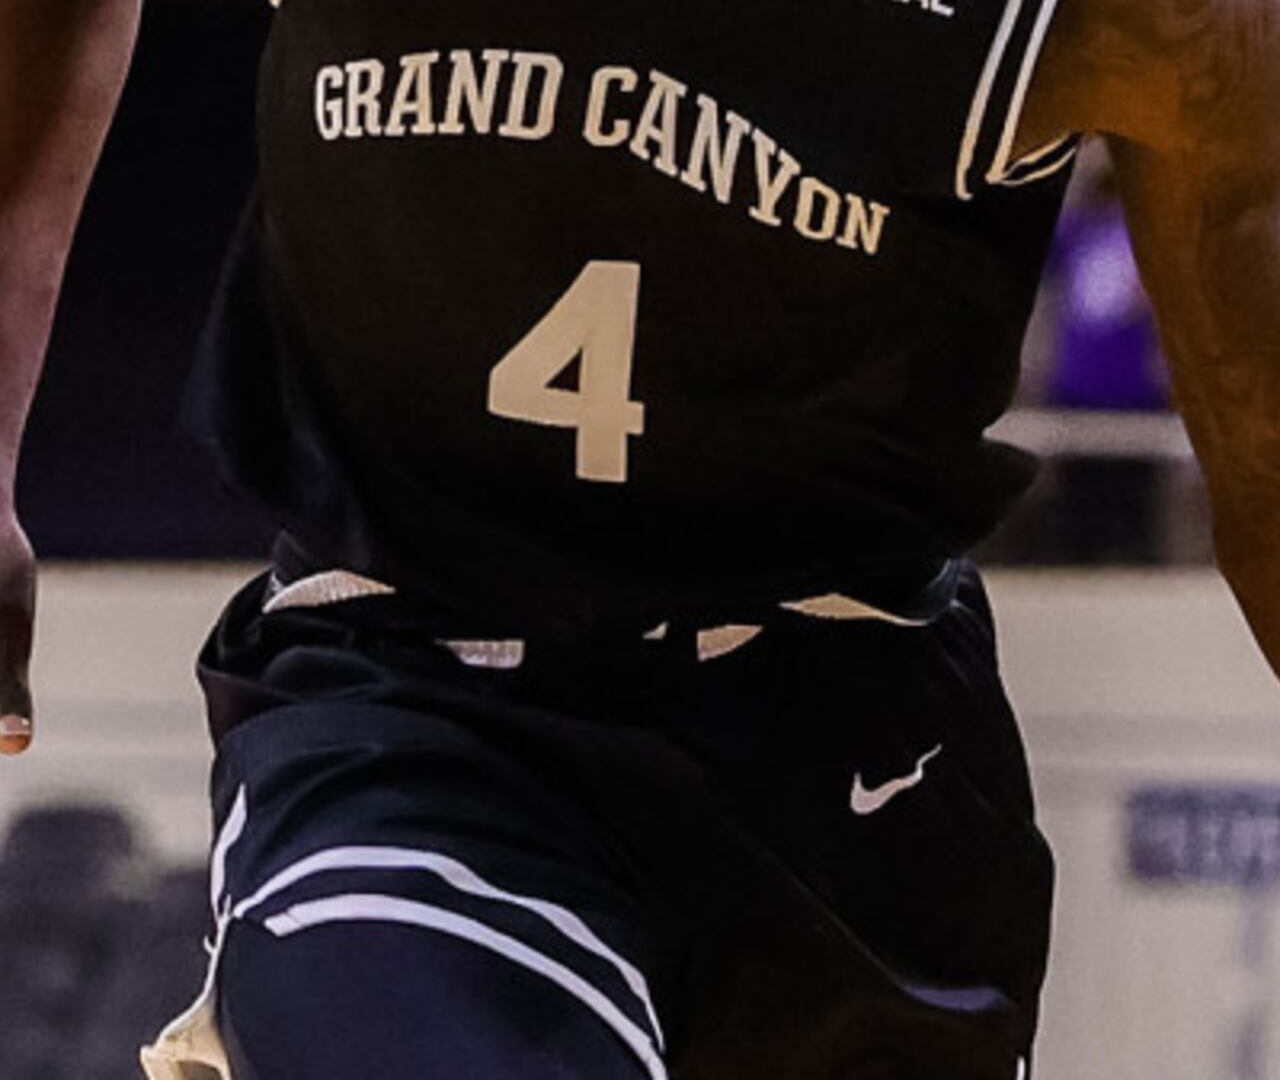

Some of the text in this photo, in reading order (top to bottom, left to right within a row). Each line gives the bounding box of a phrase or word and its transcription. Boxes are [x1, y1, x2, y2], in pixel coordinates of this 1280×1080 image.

[315, 49, 890, 255] GRAND CANYON
[487, 260, 644, 483] 4
